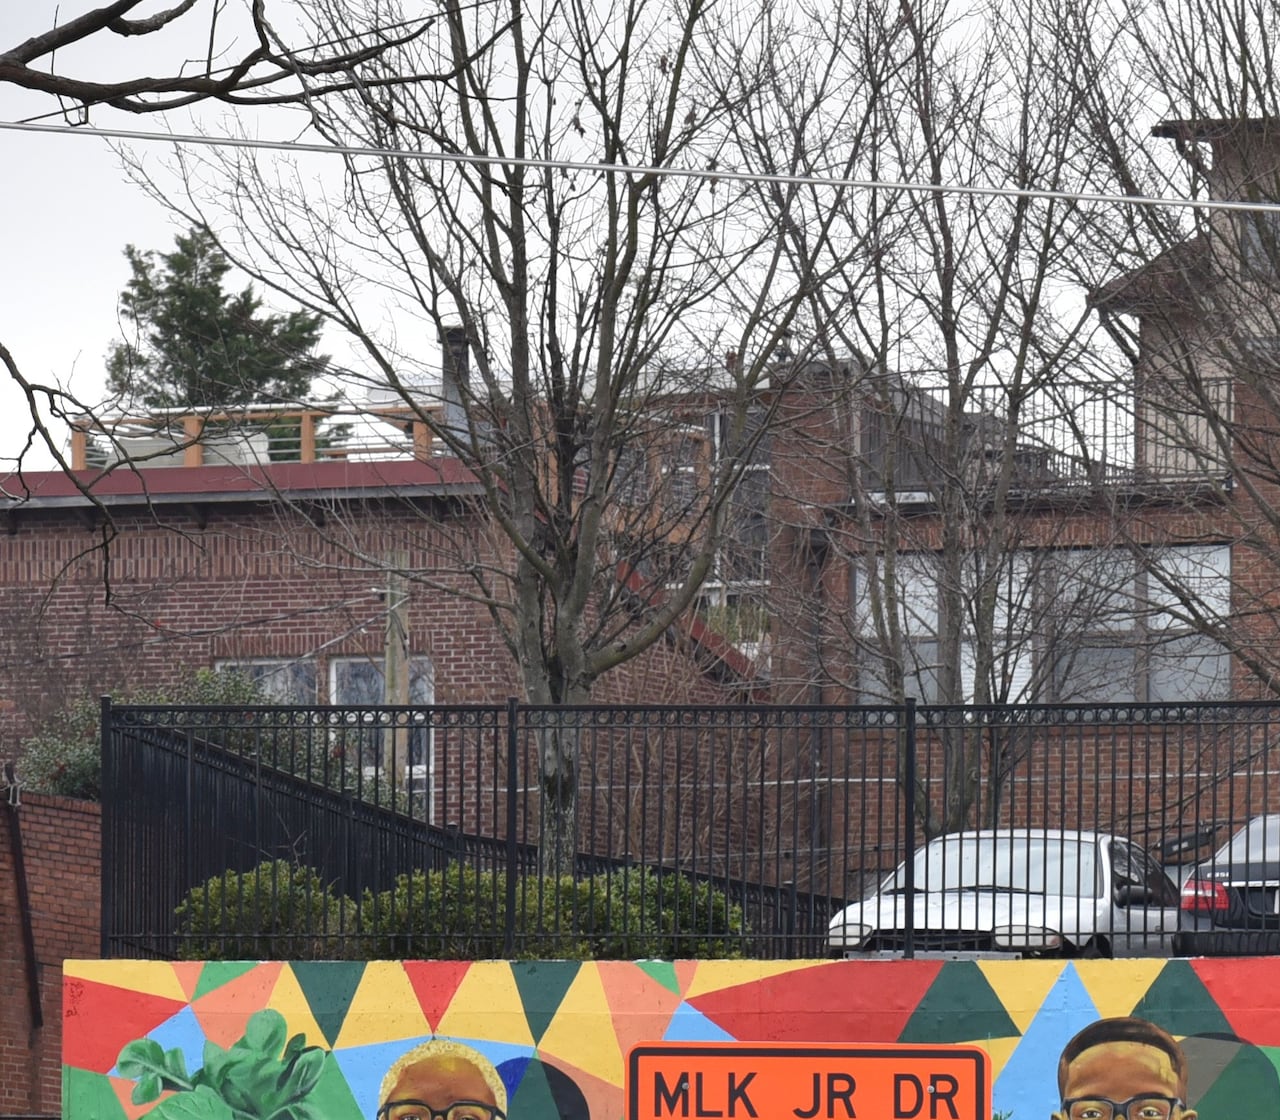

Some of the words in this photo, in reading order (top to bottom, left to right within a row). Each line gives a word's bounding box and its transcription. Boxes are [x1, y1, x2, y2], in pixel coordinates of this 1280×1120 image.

[653, 1071, 759, 1119] MLK
[792, 1072, 857, 1120] JR
[893, 1073, 960, 1120] DR
